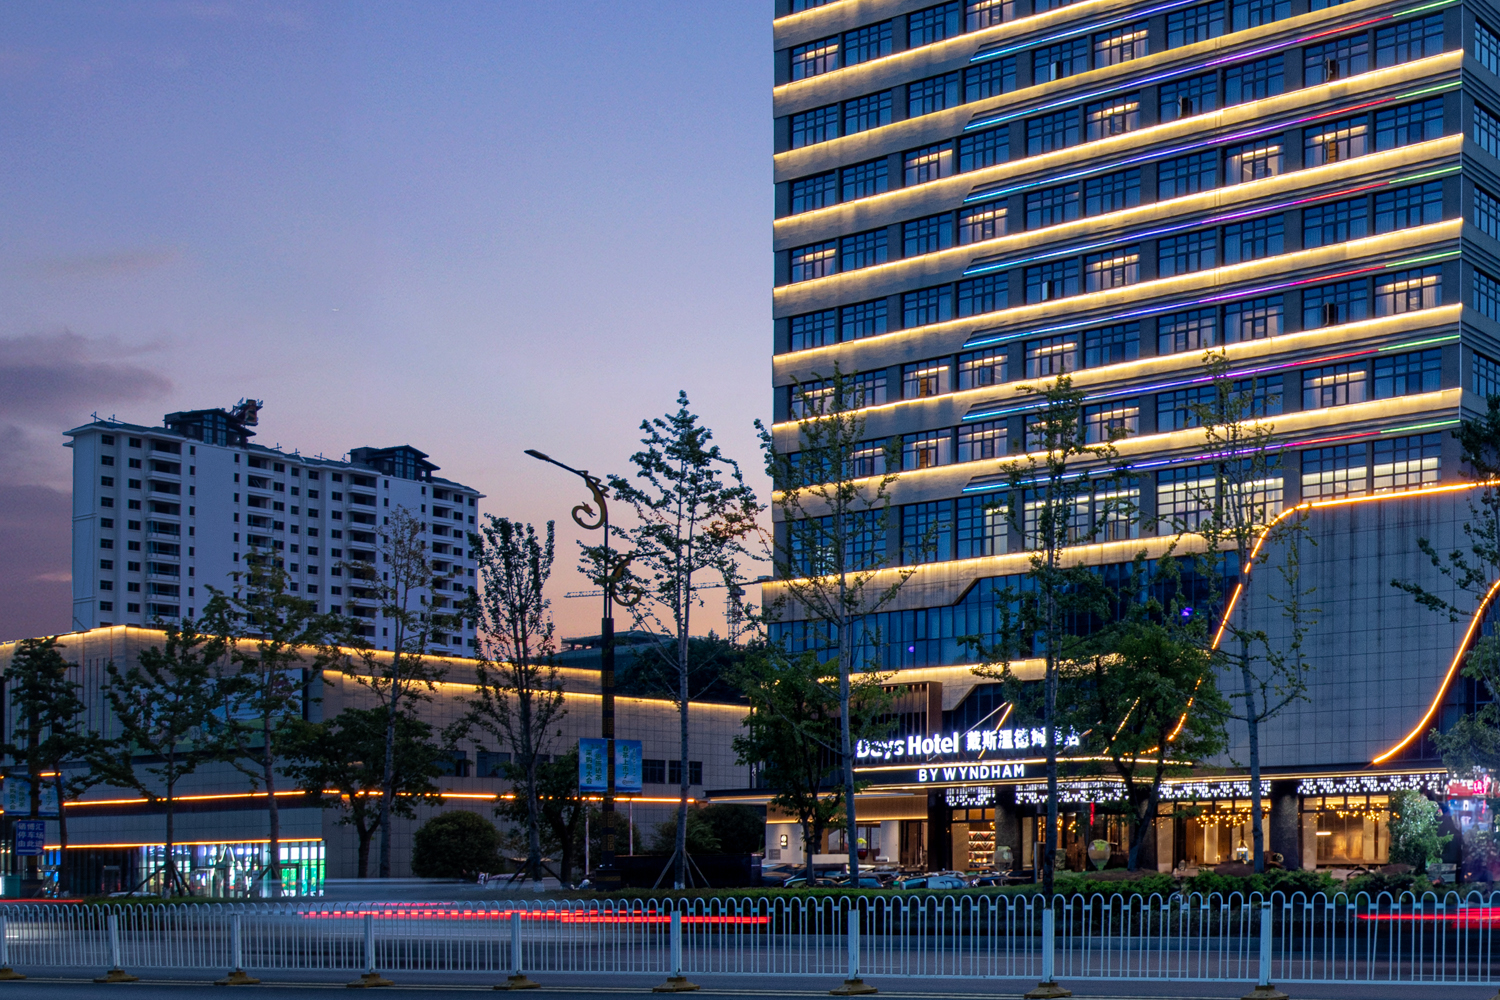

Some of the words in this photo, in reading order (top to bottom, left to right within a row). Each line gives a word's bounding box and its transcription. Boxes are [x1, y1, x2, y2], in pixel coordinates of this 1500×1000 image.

[907, 731, 959, 755] Hotel
[919, 768, 938, 782] BY
[943, 764, 1025, 781] WYNDHAM
